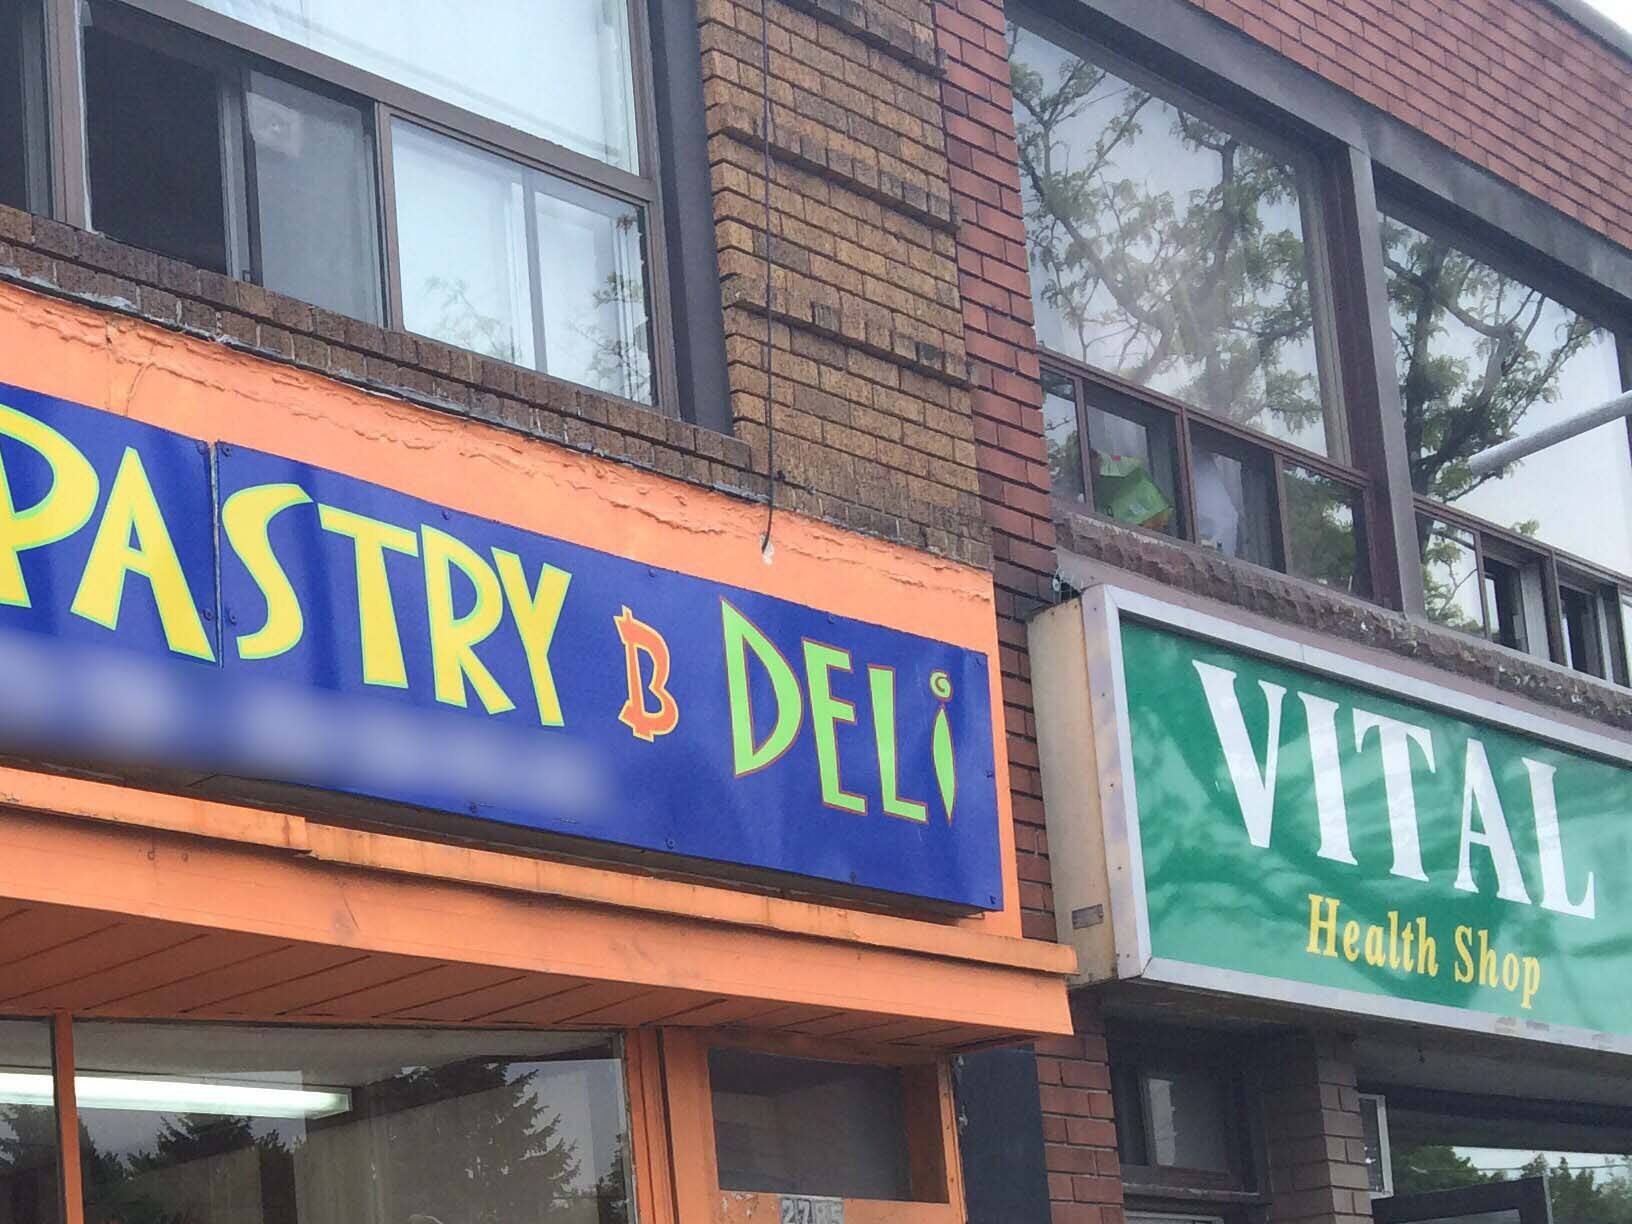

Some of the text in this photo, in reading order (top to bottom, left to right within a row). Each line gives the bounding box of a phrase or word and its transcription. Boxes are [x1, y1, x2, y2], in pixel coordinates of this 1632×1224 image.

[1191, 659, 1595, 920] VITAL
[1306, 893, 1542, 1010] Health Shop
